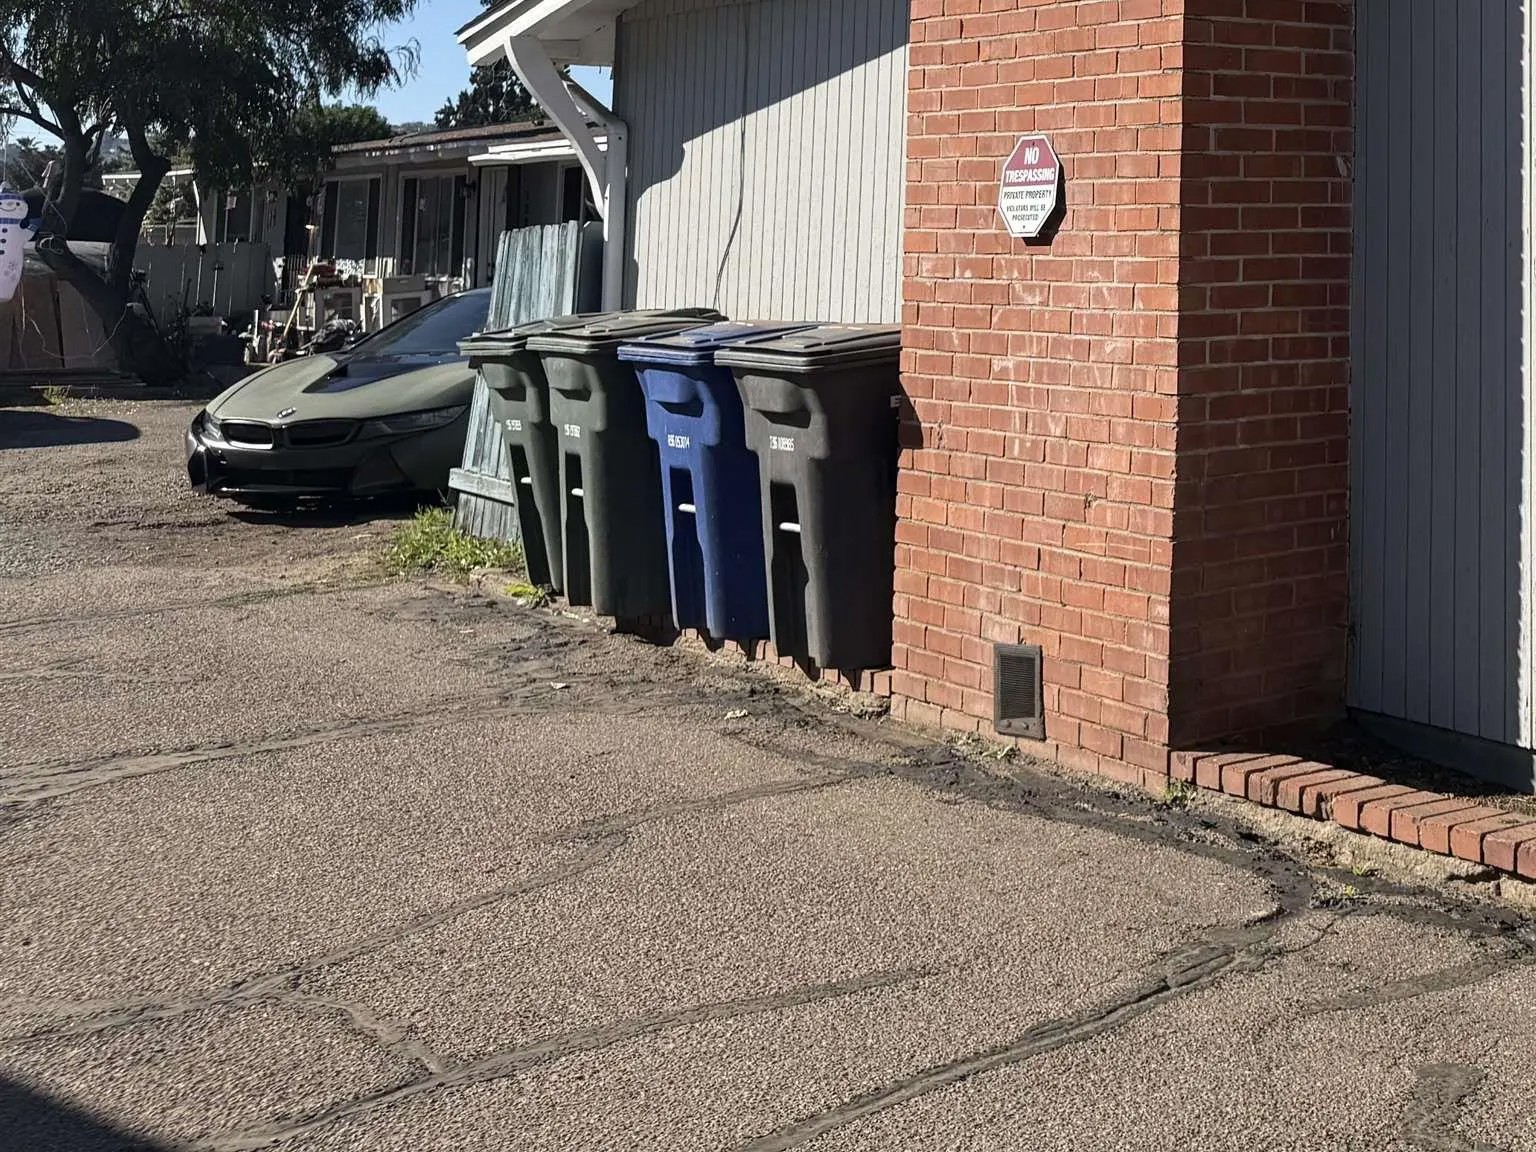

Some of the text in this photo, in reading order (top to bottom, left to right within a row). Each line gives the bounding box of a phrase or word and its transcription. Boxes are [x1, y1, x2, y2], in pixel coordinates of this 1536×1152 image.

[1024, 147, 1040, 165] NO
[1005, 168, 1055, 183] TRESPASSING
[1003, 190, 1052, 200] PRIVATE PROPERTY
[1006, 204, 1028, 212] VIOLATORS
[1029, 204, 1039, 212] WILL
